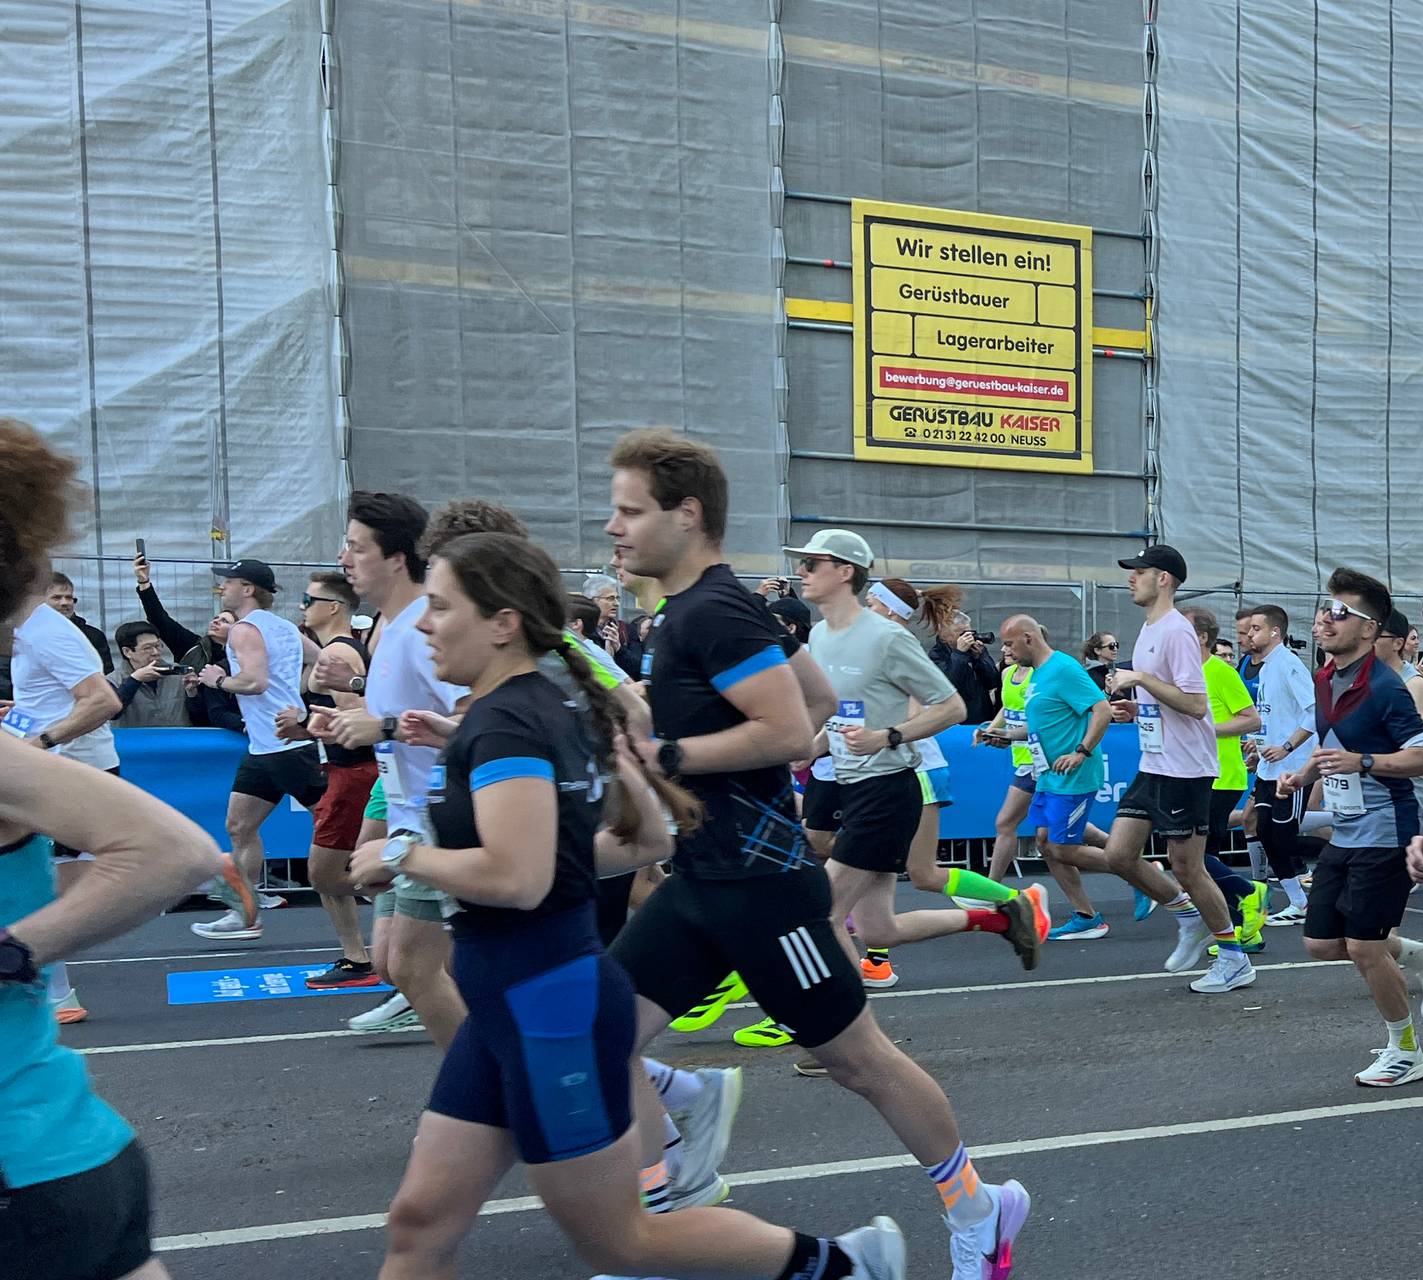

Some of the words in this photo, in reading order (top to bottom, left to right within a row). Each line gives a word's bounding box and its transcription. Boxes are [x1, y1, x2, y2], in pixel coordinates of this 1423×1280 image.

[895, 237, 933, 259] Wir
[940, 245, 1008, 267] stellen
[1014, 251, 1051, 272] ein!
[899, 283, 1010, 309] Gerüstbauer
[937, 329, 1055, 355] Lagerarbeiter
[885, 370, 1064, 396] bewerbung@geruestbau-kaiser.de
[889, 404, 994, 428] GERÜSTBAU
[1000, 413, 1061, 433] KAISER
[1011, 435, 1046, 446] NEUSS
[1094, 782, 1128, 803] er
